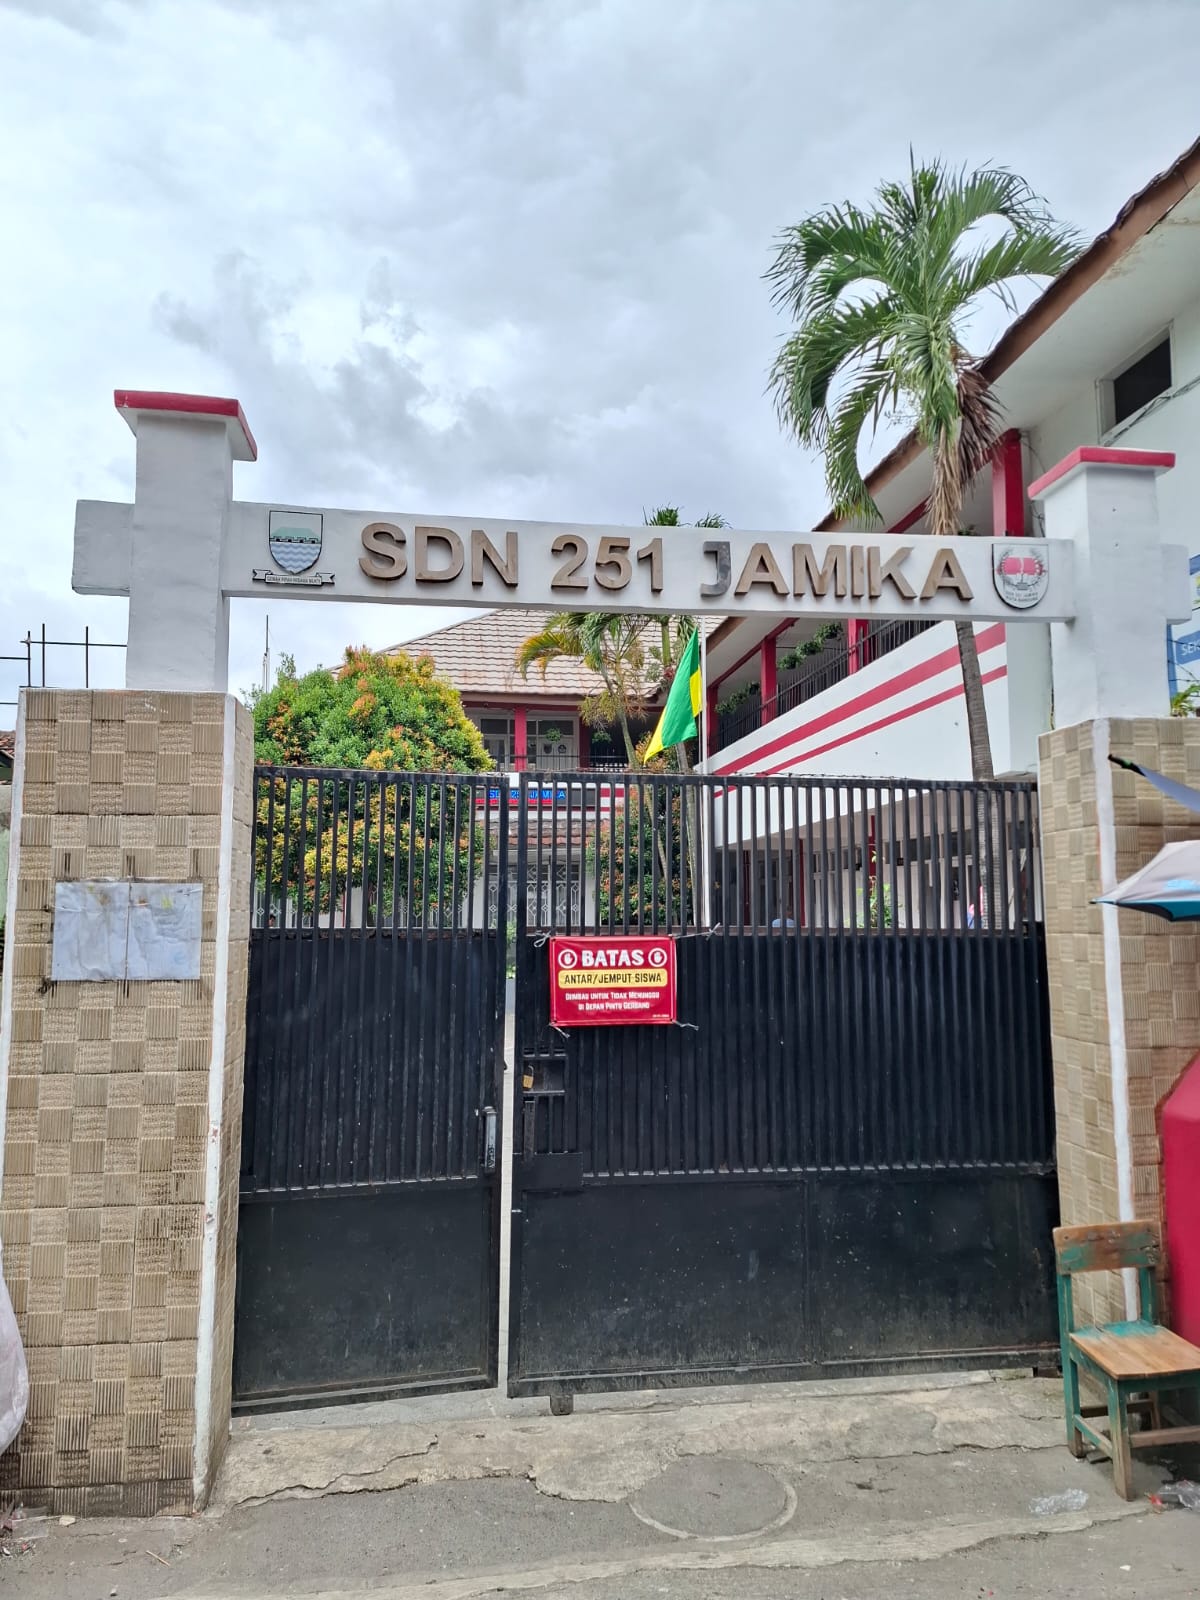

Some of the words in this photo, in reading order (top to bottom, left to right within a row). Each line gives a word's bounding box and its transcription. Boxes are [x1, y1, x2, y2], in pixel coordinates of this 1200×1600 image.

[358, 522, 518, 587] SDN
[550, 534, 663, 593] 251
[700, 541, 973, 601] JAMIKA
[581, 949, 645, 967] BATAS
[564, 973, 632, 985] ANTAR/JEMPUT
[635, 972, 662, 983] SISWA
[610, 991, 627, 999] TIDAK
